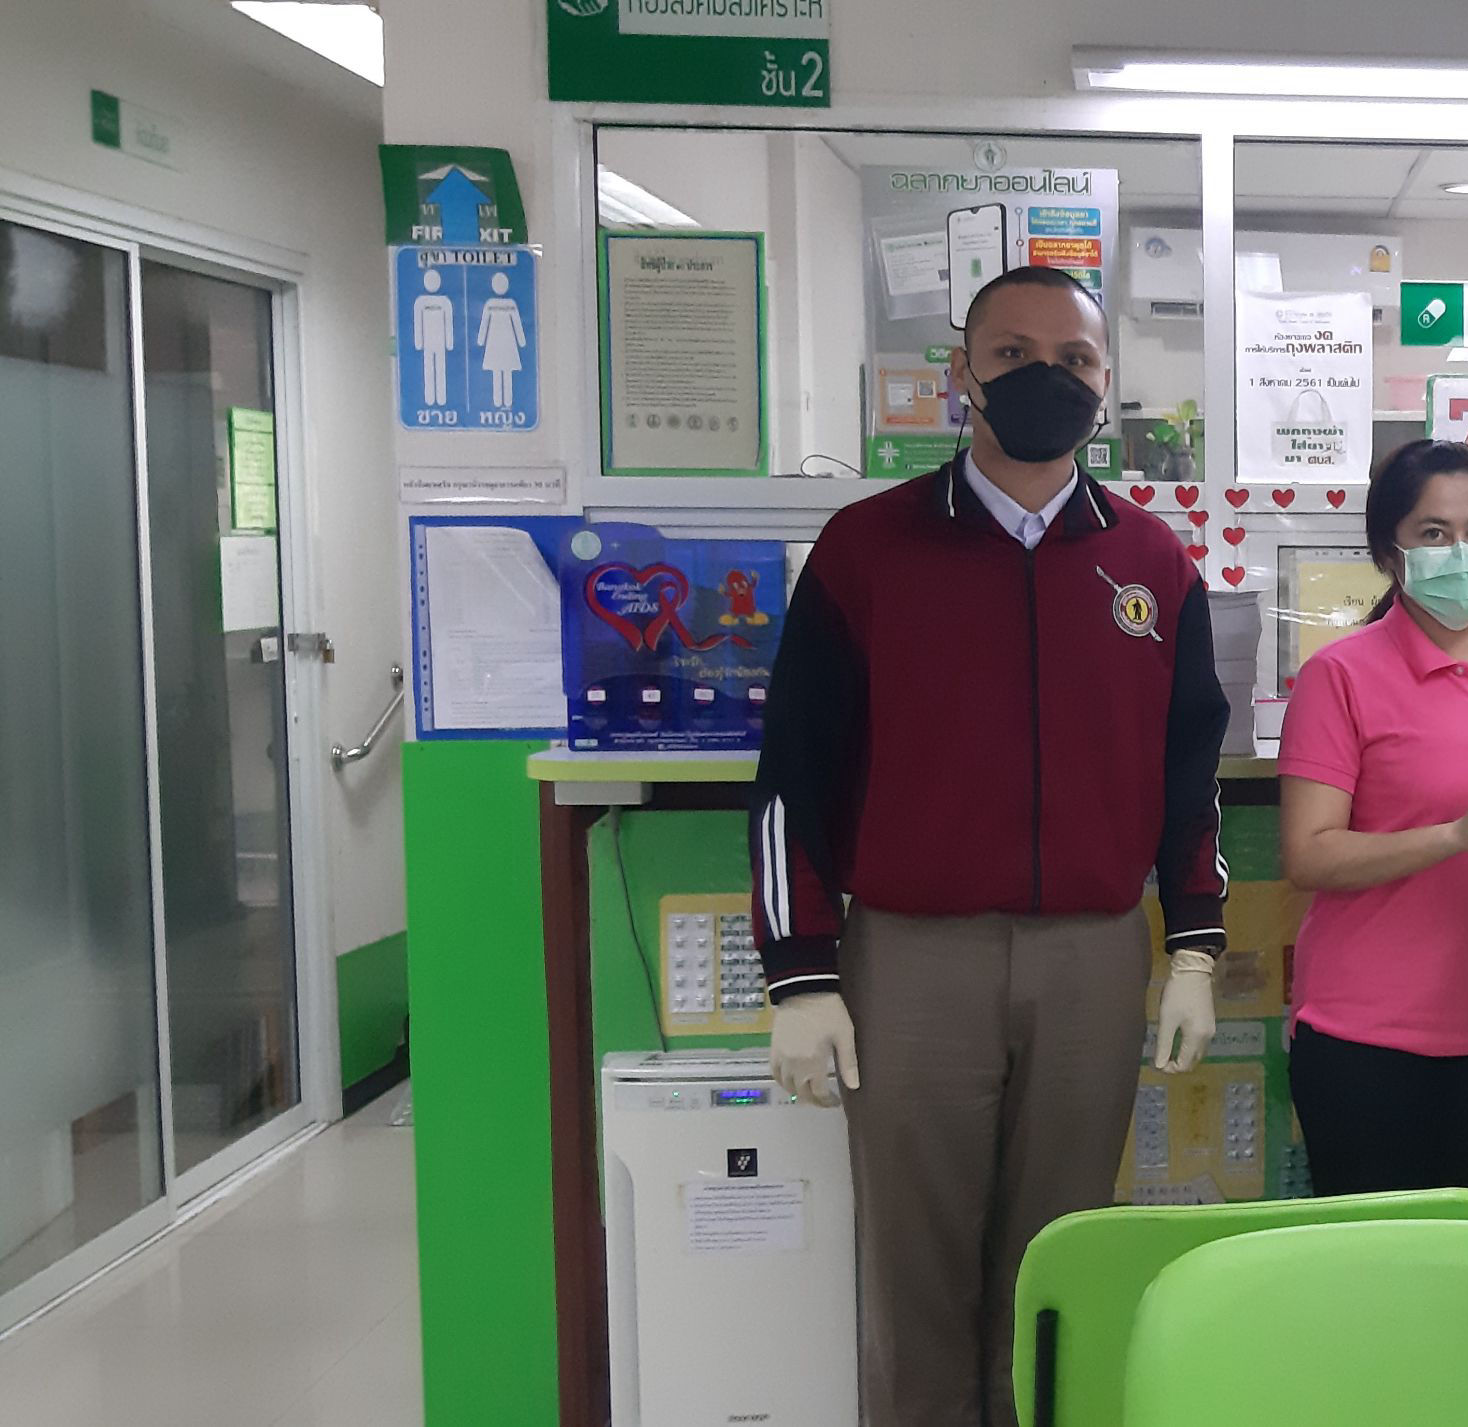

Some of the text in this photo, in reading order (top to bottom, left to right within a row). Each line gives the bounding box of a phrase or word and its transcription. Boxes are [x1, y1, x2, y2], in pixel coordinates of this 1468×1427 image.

[761, 51, 824, 97] ชั้น 2
[890, 169, 1092, 195] ฉลากยาออนไลน์
[411, 225, 513, 242] FIR XIT
[453, 251, 513, 265] TOILET
[1314, 330, 1333, 341] งด
[1249, 376, 1360, 388] 1 สิงหาคม 2561 เป็นต้นไป
[417, 407, 526, 430] ชาย หญิง
